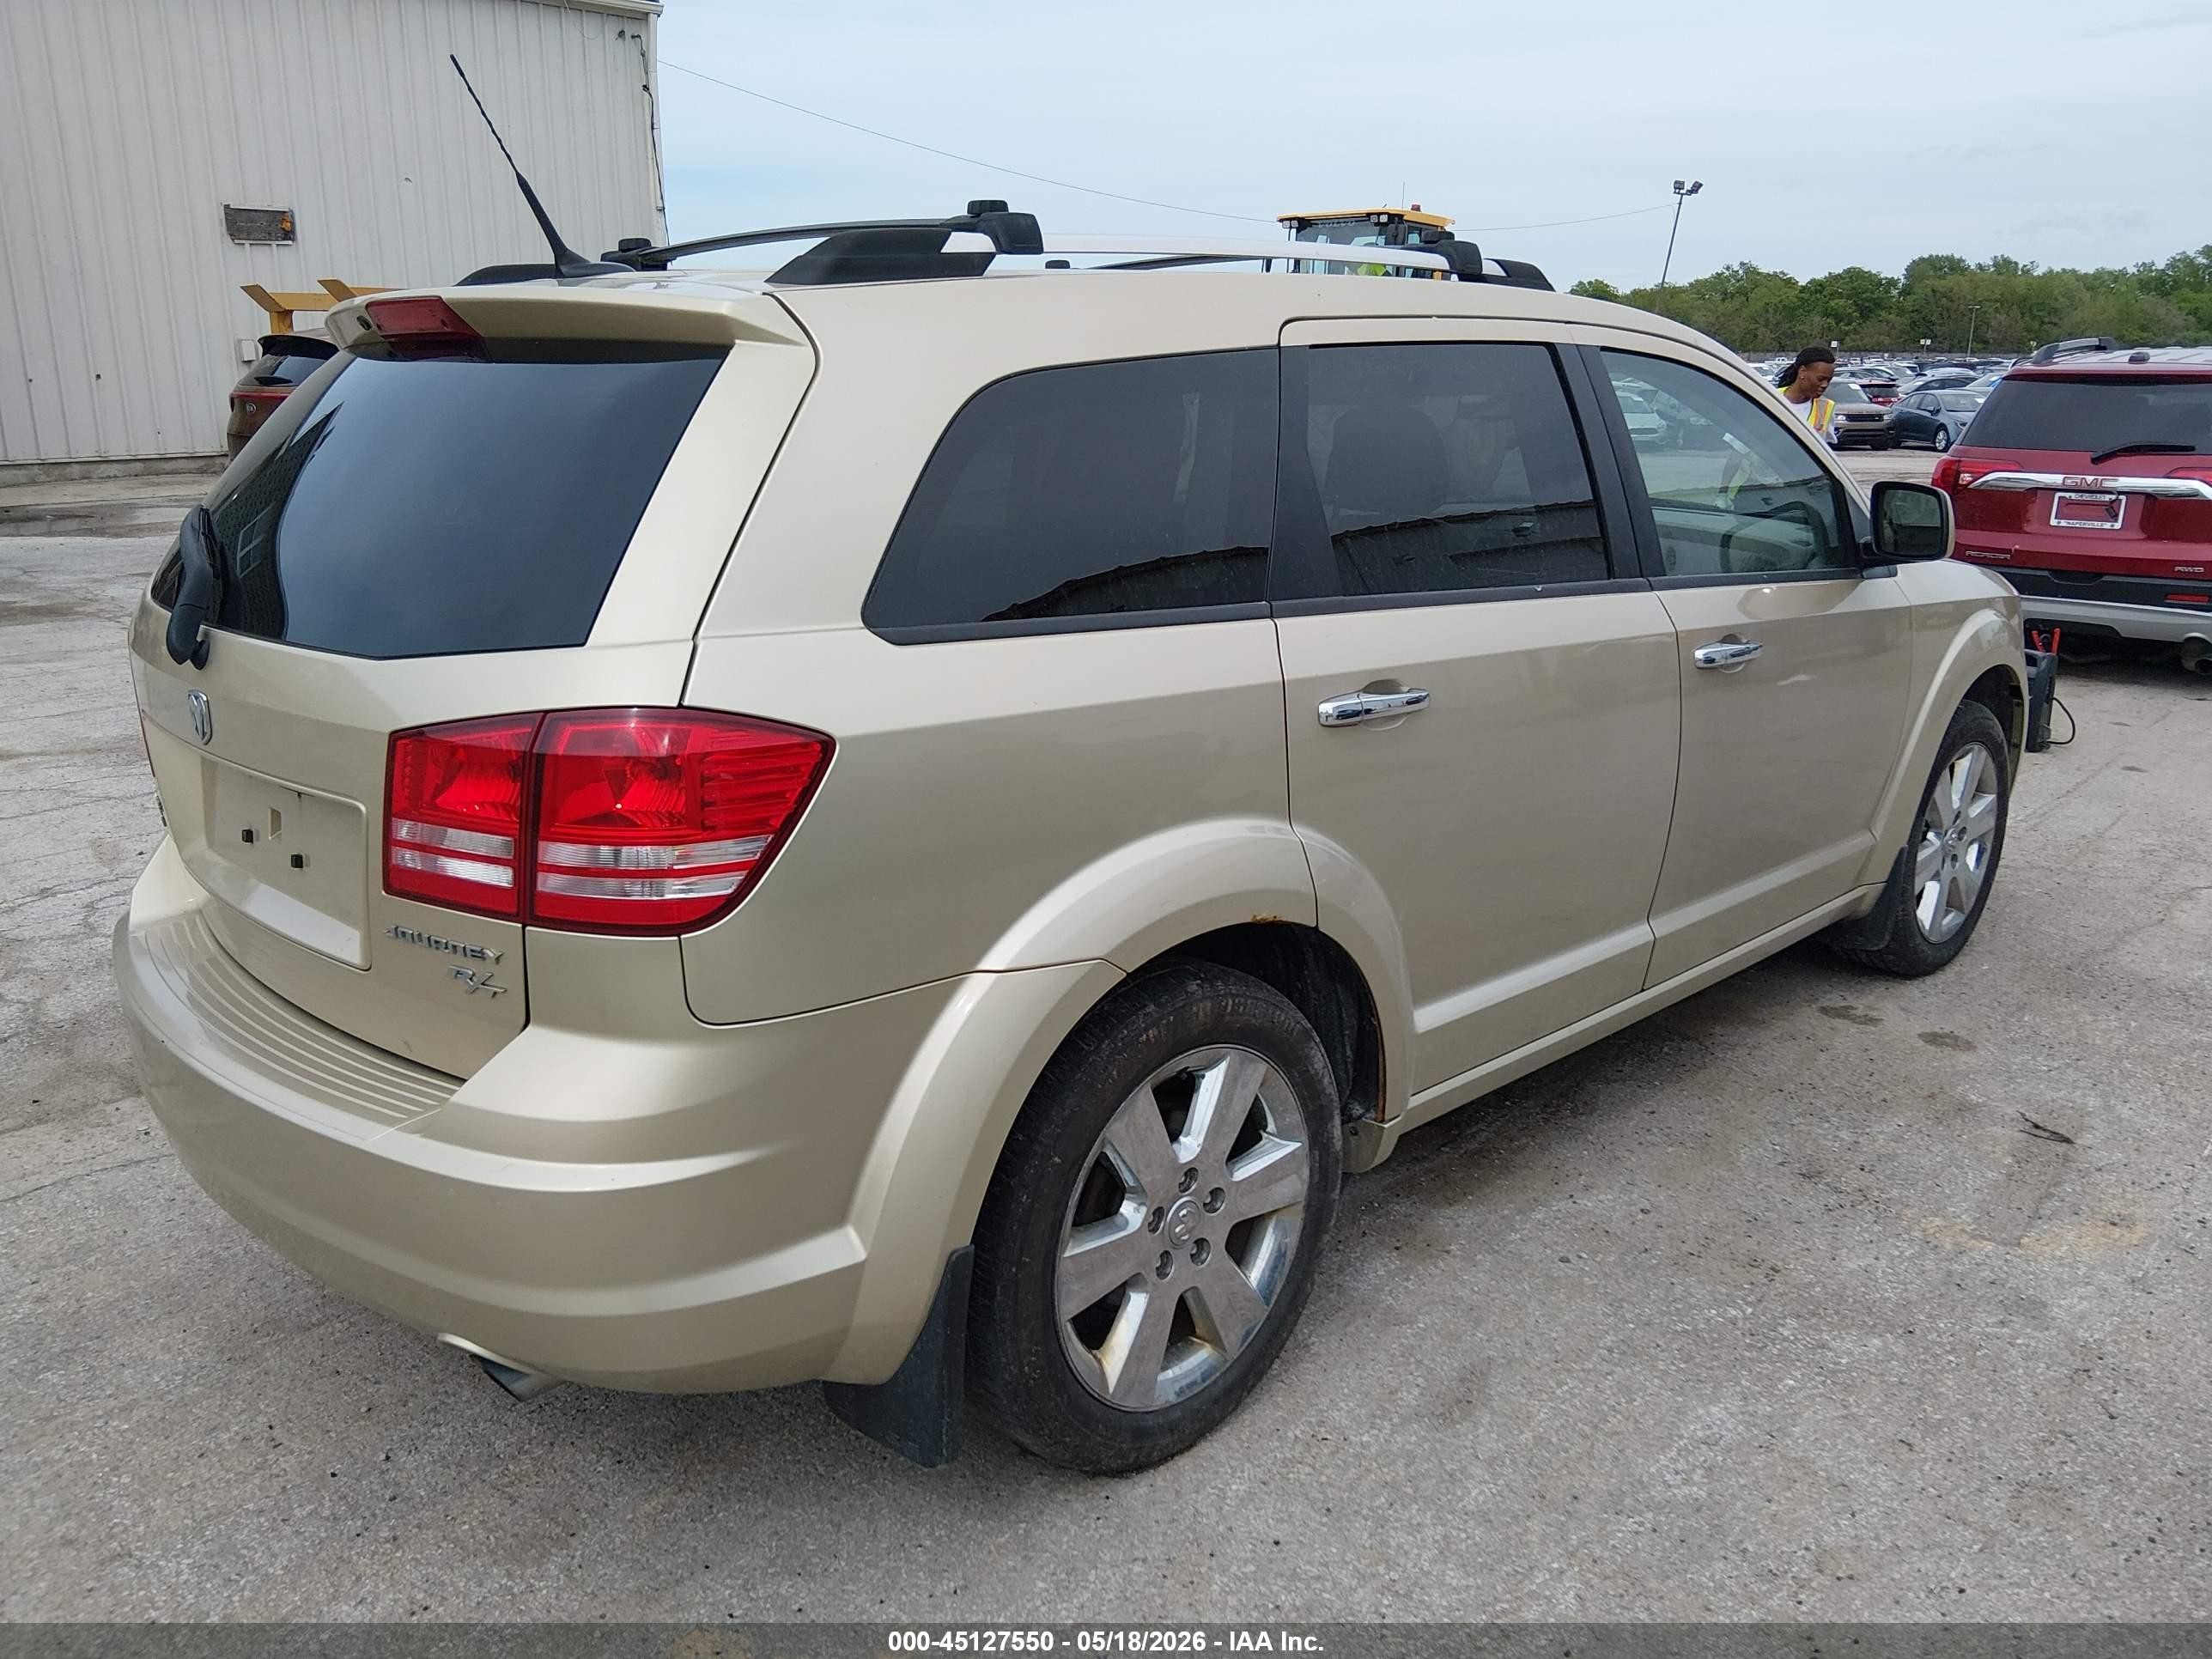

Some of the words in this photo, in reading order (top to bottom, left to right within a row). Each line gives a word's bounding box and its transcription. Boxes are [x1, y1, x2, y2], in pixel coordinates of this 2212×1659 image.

[2063, 477, 2120, 490] GMC
[384, 925, 503, 964] JOURNEY
[447, 964, 507, 998] R/T
